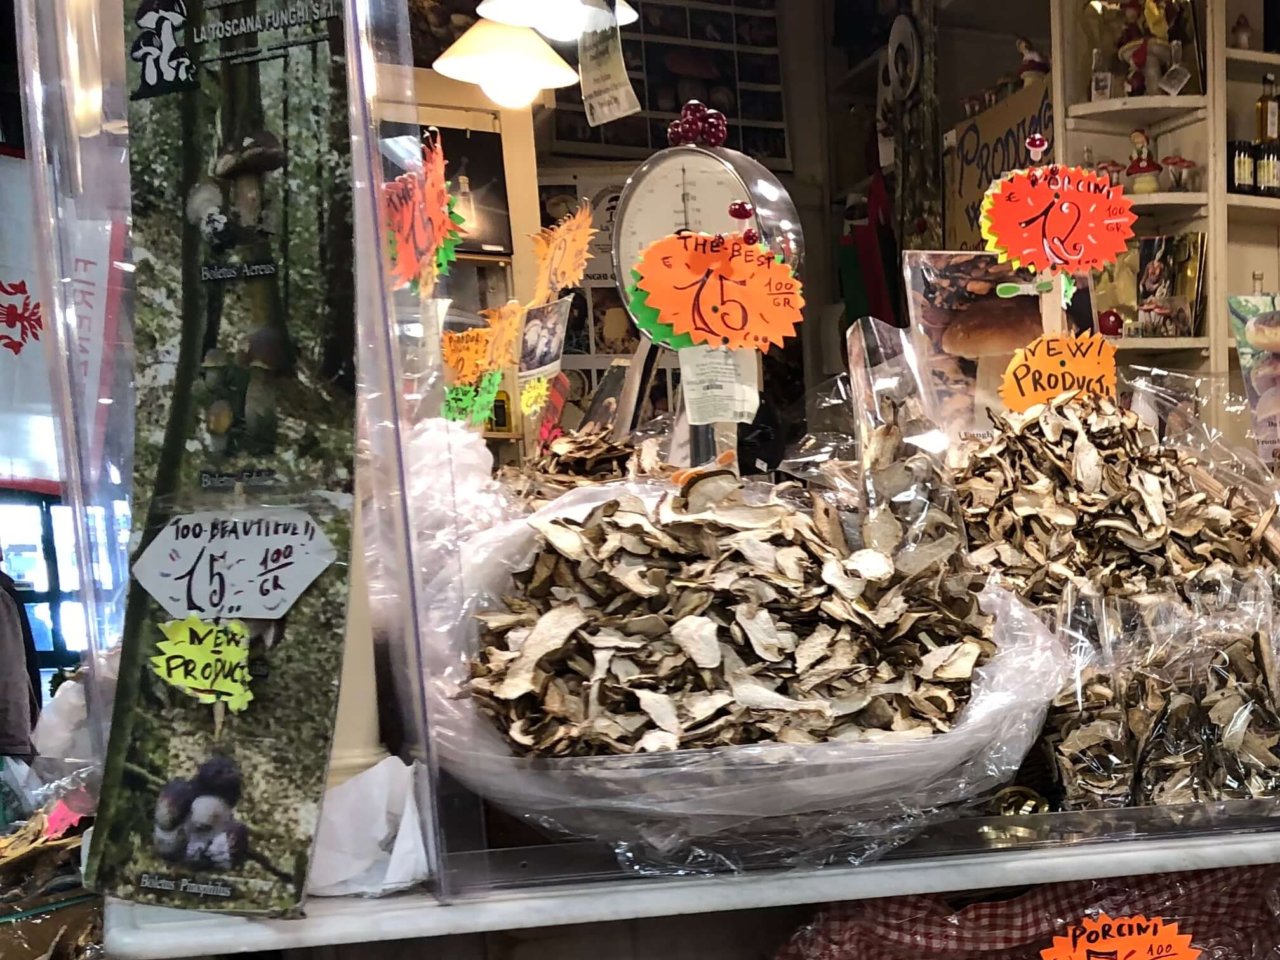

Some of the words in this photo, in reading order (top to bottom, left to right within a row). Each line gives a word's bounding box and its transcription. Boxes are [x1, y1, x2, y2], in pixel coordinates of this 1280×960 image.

[193, 27, 208, 43] LA
[211, 19, 263, 39] TOSCANA
[265, 9, 309, 30] FUNGHI
[1106, 205, 1125, 216] 100
[201, 266, 238, 281] Boletus
[242, 262, 276, 277] Aereus
[764, 278, 795, 293] 100
[260, 545, 293, 570] 100
[1071, 922, 1160, 952] PORCINI
[1145, 943, 1174, 957] 100
